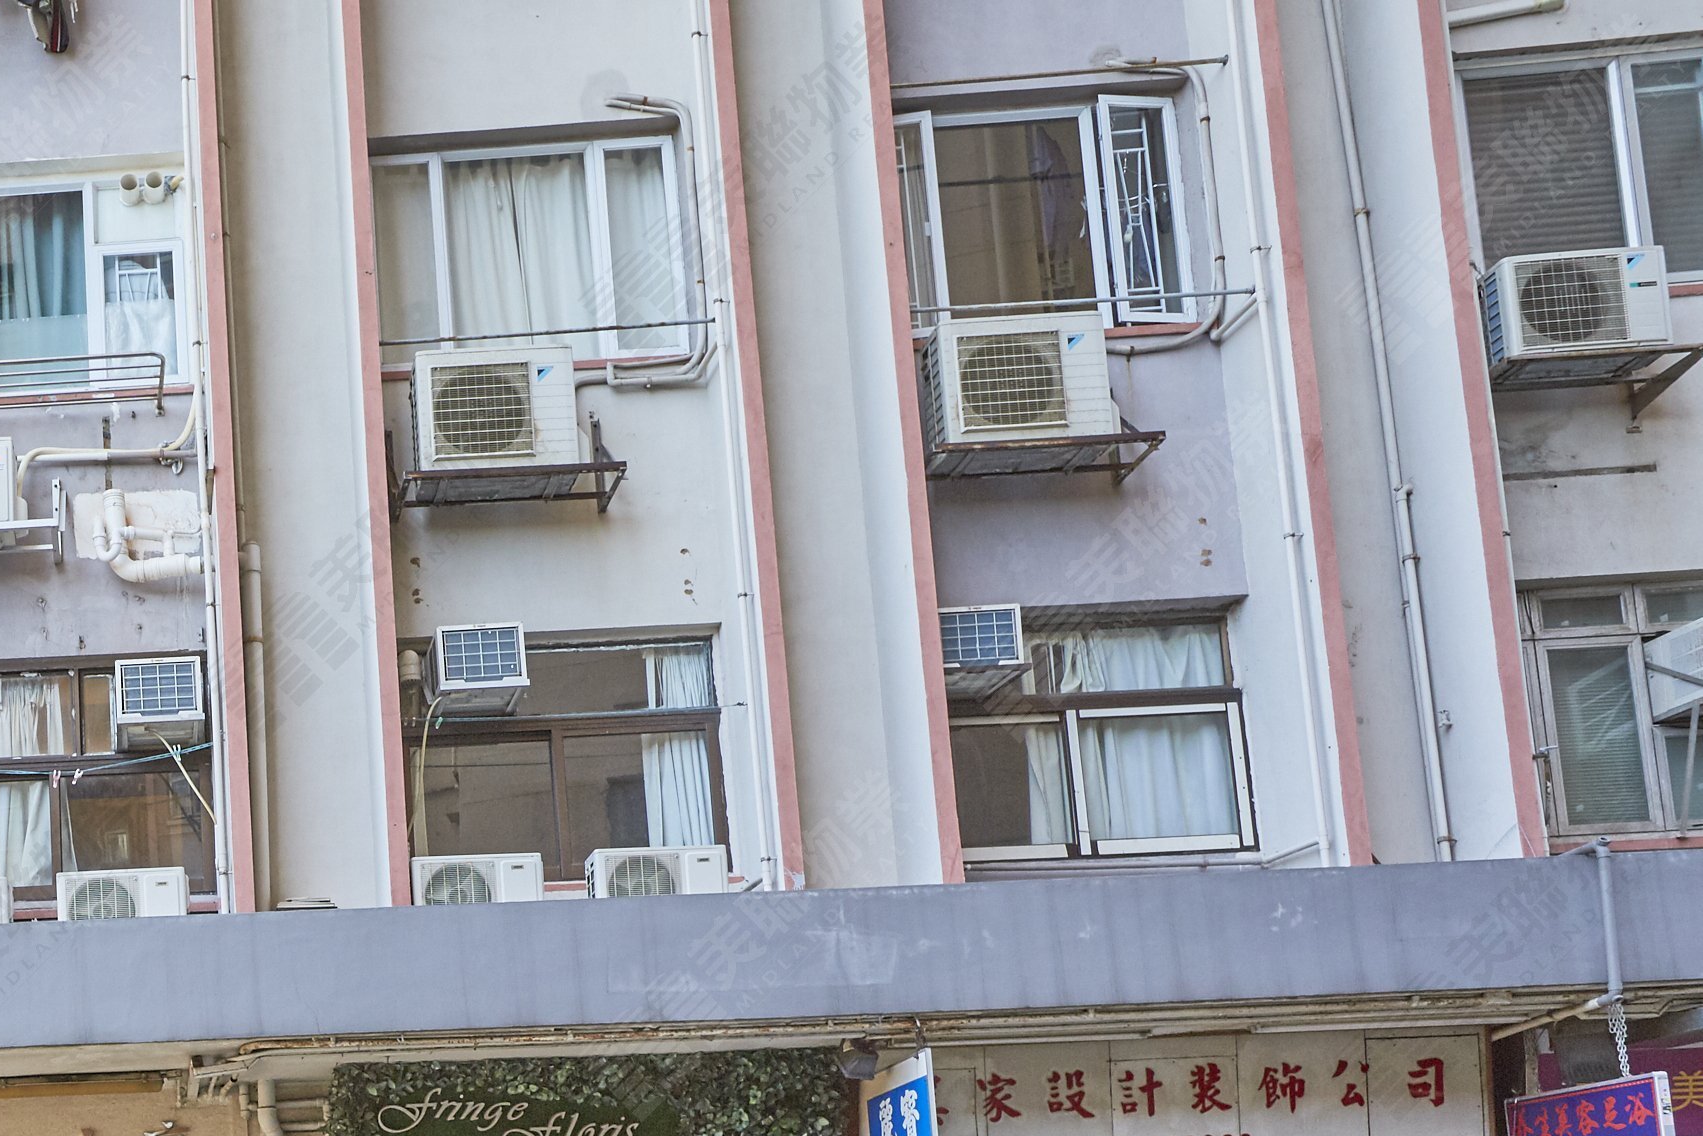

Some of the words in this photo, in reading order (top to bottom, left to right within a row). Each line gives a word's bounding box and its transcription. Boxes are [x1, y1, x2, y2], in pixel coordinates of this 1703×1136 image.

[935, 1057, 1446, 1126] 家設計裝飾公司
